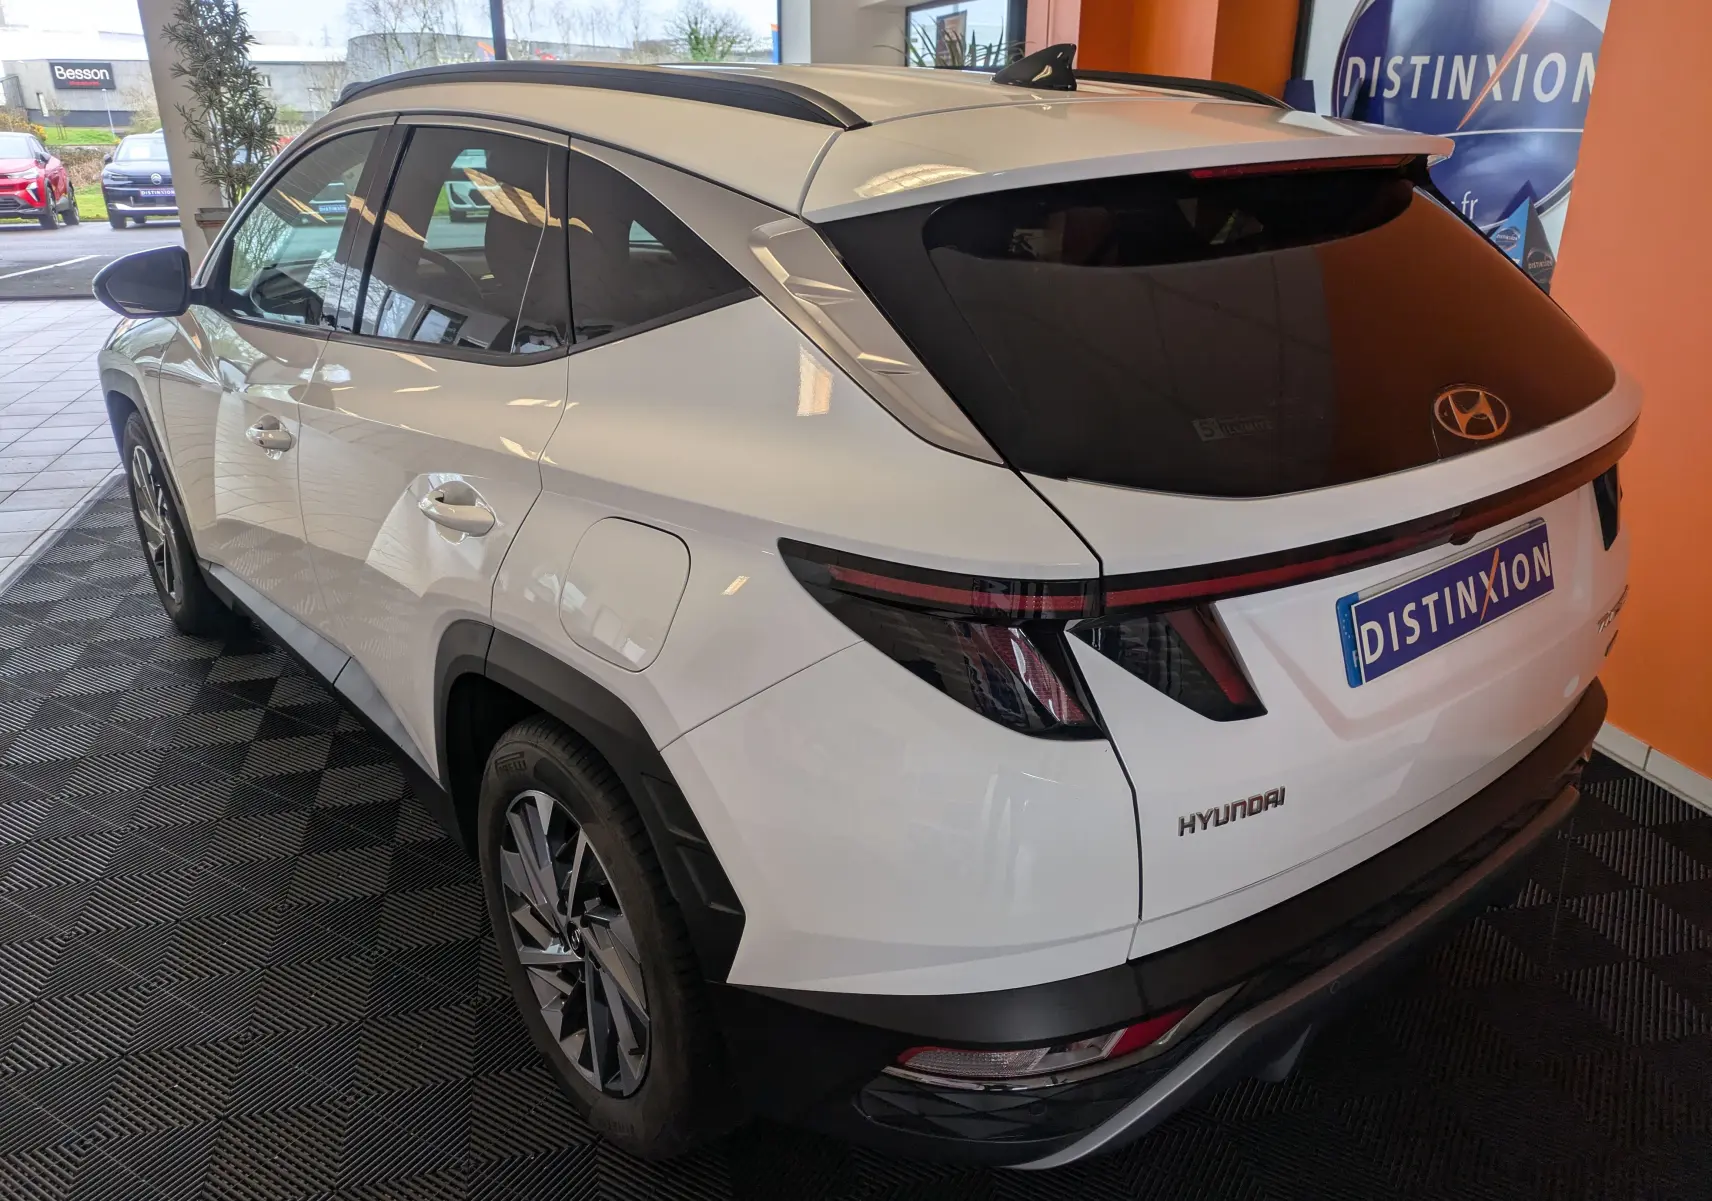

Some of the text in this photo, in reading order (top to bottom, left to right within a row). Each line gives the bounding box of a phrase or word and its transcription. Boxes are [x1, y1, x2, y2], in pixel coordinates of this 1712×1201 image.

[54, 65, 110, 79] Besson
[1343, 52, 1596, 103] DISTINXION
[1360, 542, 1551, 665] DISTINXION
[1178, 785, 1286, 837] HYUNDAI
